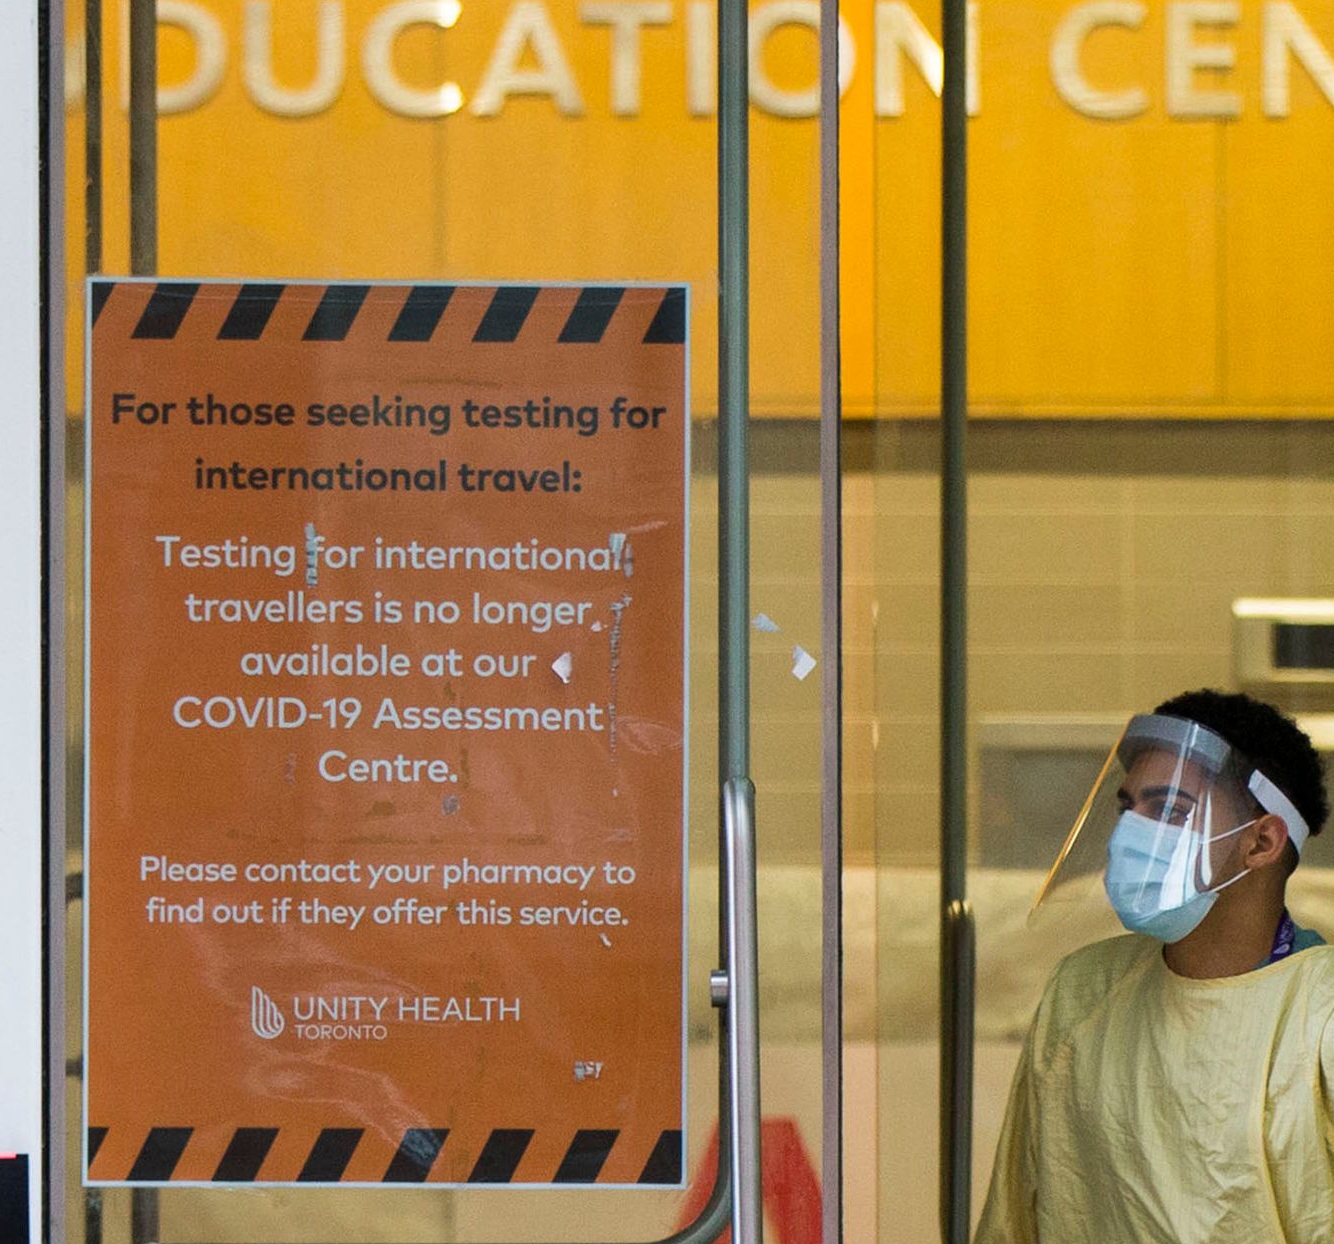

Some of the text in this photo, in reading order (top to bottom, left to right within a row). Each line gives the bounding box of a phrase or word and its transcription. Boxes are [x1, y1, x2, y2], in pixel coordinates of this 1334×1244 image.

[112, 393, 666, 436] For those seeking testing for
[195, 457, 581, 492] international travel:
[156, 536, 623, 576] Testing for international
[185, 591, 591, 631] travellers is no longer
[241, 644, 536, 677] available at our
[173, 696, 603, 731] COVID-19 Assessment
[319, 750, 457, 782] Centre.
[141, 856, 635, 888] Please contact your pharmacy to
[146, 897, 628, 930] find out if they offer this service.
[294, 996, 520, 1021] UNITY HEALTH
[295, 1024, 387, 1040] TORONTO
